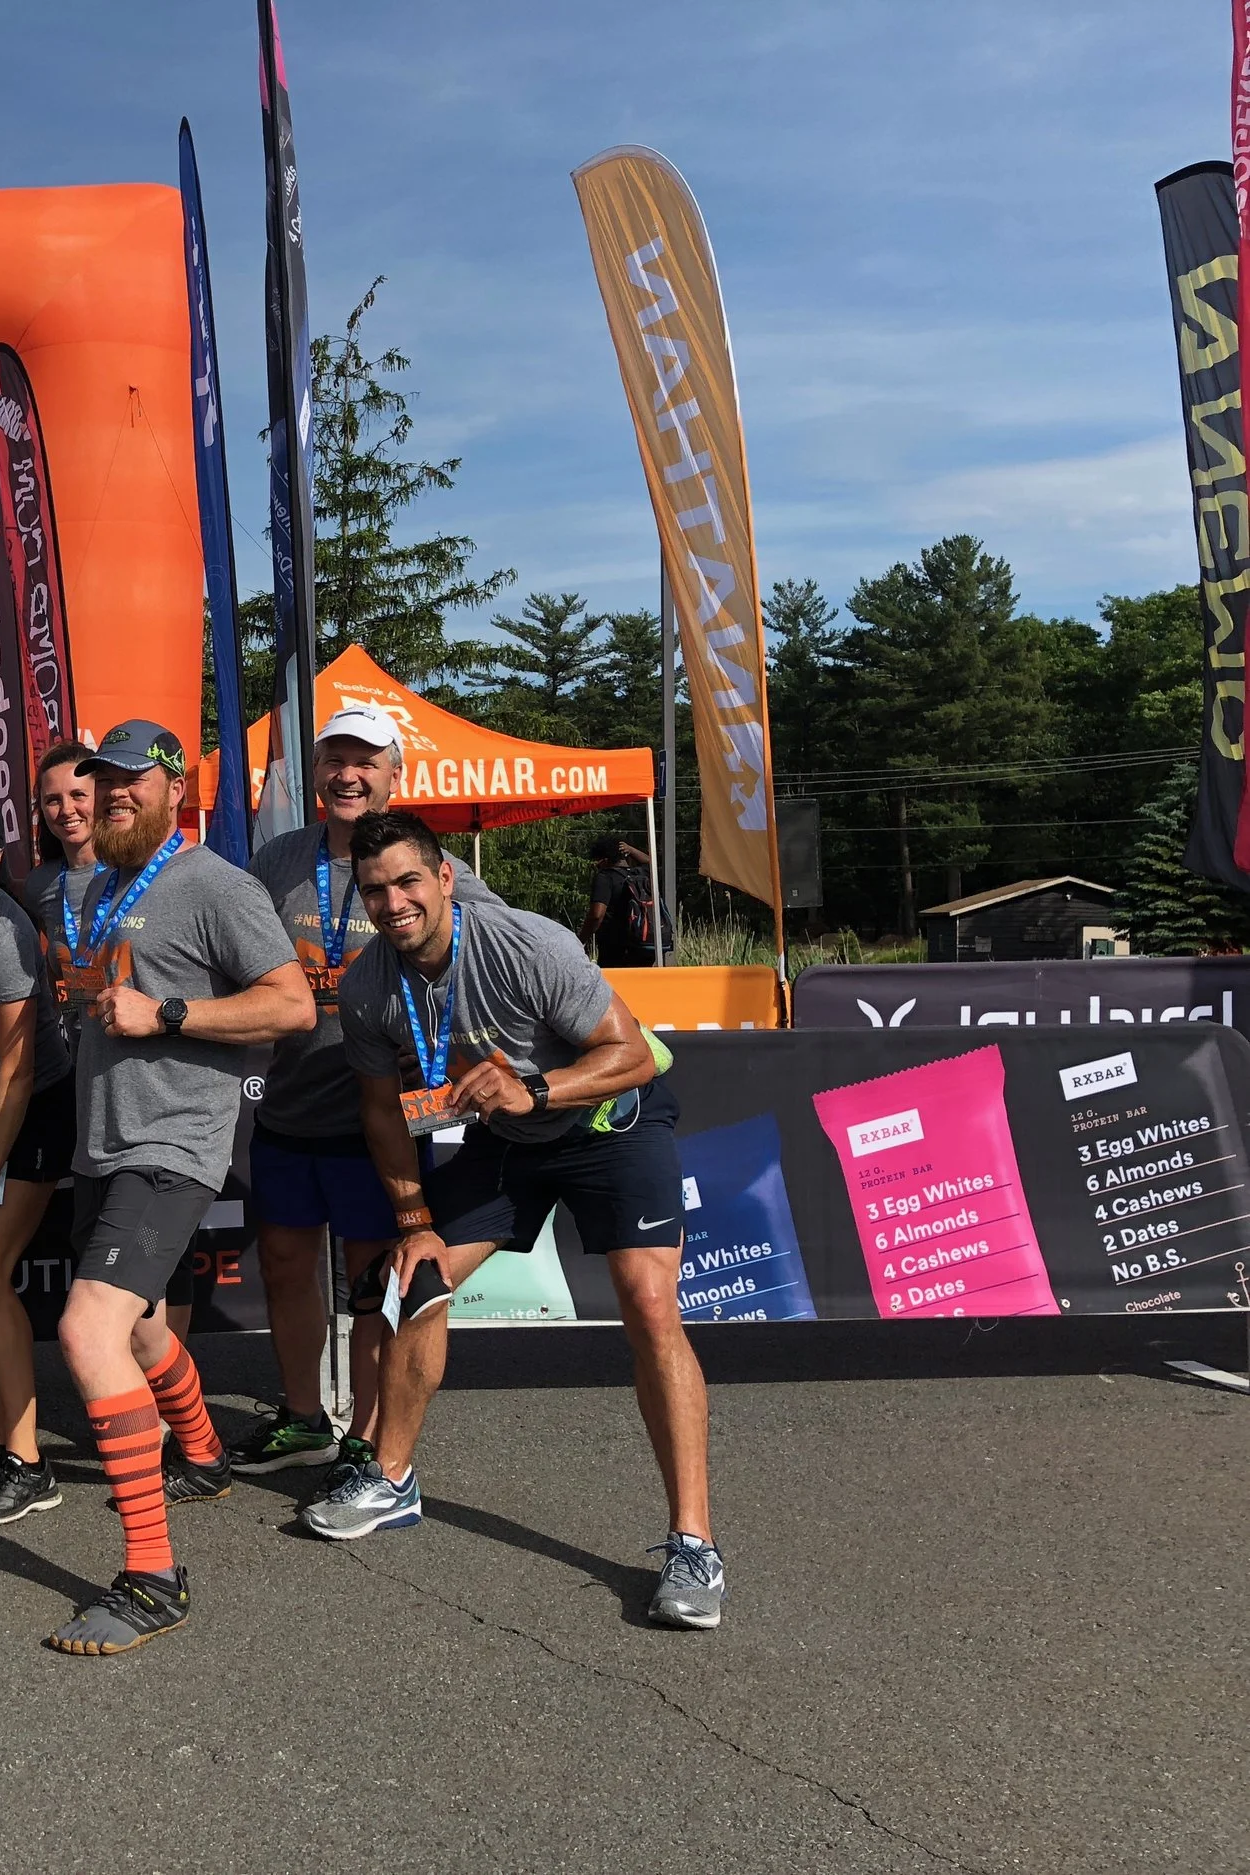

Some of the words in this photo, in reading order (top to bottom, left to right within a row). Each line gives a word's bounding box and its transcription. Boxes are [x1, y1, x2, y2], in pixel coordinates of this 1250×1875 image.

[333, 681, 384, 696] Reebok
[1072, 1065, 1125, 1088] RXBAR
[1070, 1112, 1082, 1122] 12
[1086, 1109, 1098, 1118] G.
[1073, 1113, 1120, 1133] PROTEIN
[1125, 1106, 1148, 1119] BAR
[859, 1122, 912, 1145] RXBAR
[1078, 1146, 1091, 1162] 3
[1096, 1136, 1135, 1158] Egg
[1136, 1115, 1211, 1146] Whites
[858, 1169, 870, 1179] 12
[861, 1171, 906, 1190] PROTEIN
[912, 1163, 934, 1176] BAR
[1086, 1174, 1099, 1192] 6
[1105, 1150, 1194, 1188] Almonds
[866, 1203, 880, 1220] 3
[883, 1193, 921, 1216] Egg
[923, 1173, 995, 1203] Whites
[1095, 1204, 1108, 1221] 4
[1113, 1180, 1203, 1216] Cashews
[686, 1231, 709, 1243] BAR
[875, 1232, 888, 1250] 6
[893, 1208, 979, 1246] Almonds
[1103, 1234, 1117, 1252] 2
[1120, 1218, 1180, 1247] Dates
[697, 1241, 772, 1271] Whites
[883, 1263, 896, 1279] 4
[901, 1239, 990, 1275] Cashews
[1111, 1264, 1142, 1282] No
[1145, 1248, 1187, 1269] B.S.
[462, 1293, 486, 1306] BAR
[908, 1279, 966, 1306] Dates
[1125, 1289, 1182, 1313] Chocolate
